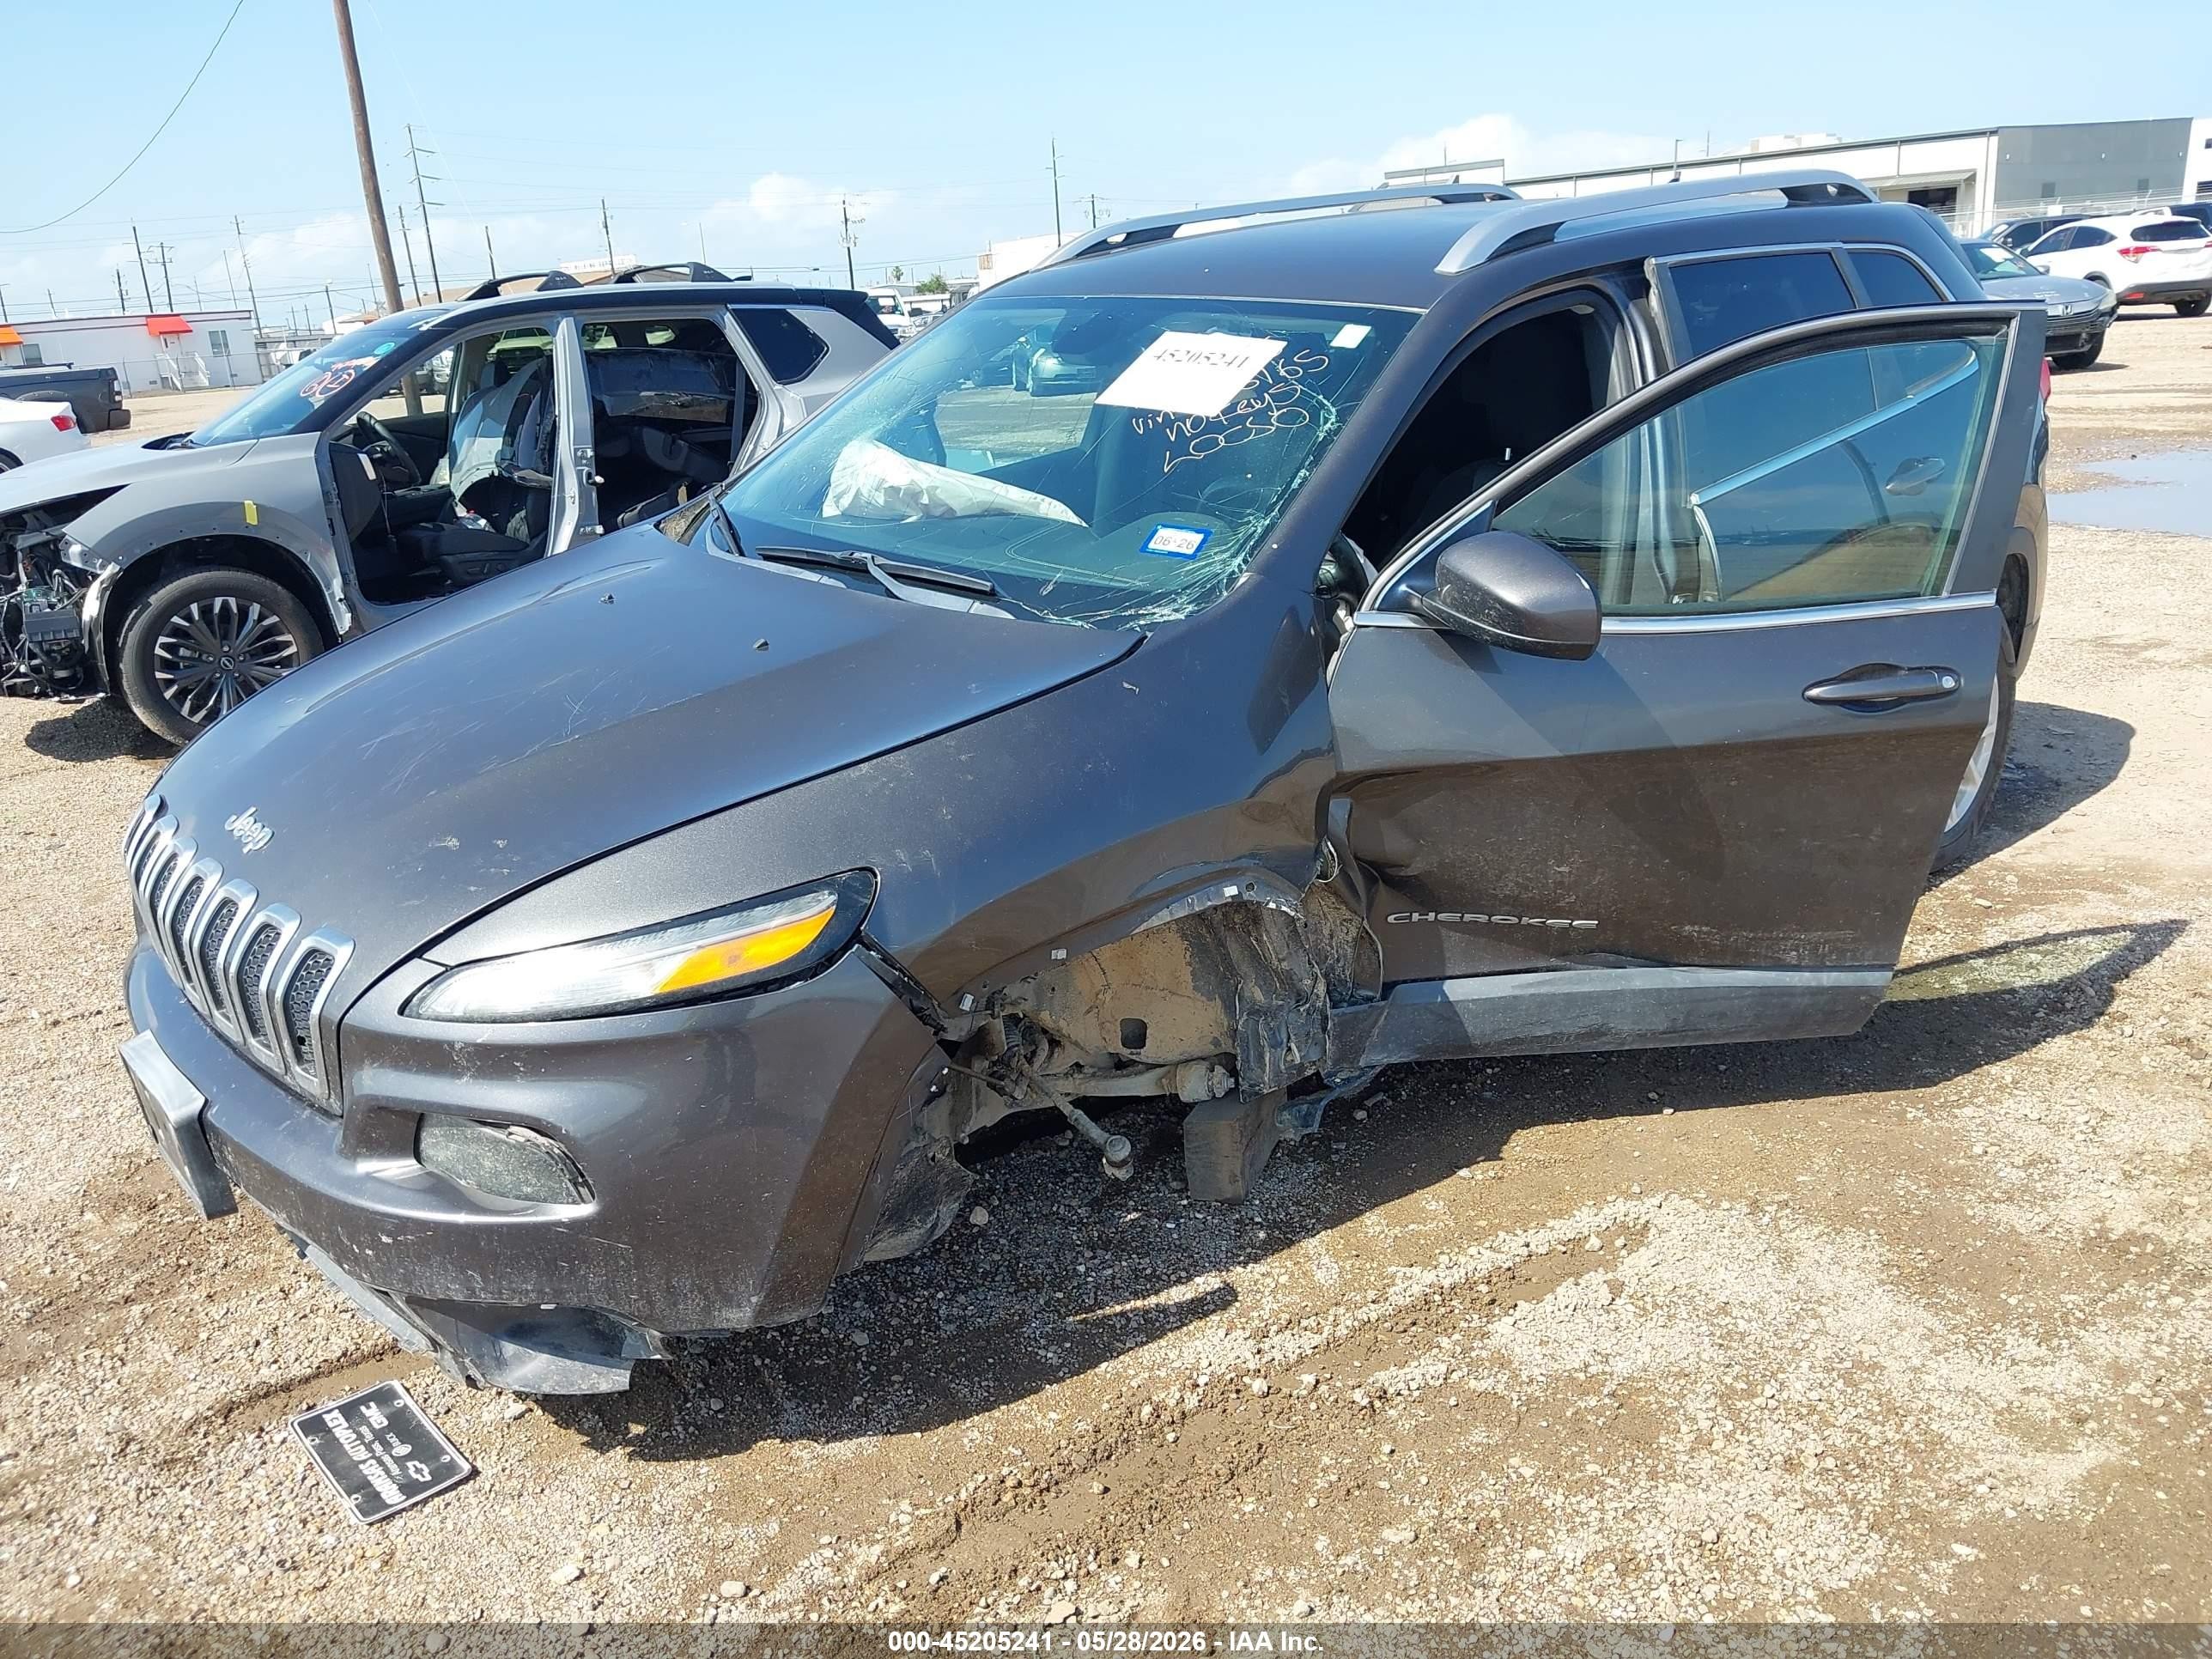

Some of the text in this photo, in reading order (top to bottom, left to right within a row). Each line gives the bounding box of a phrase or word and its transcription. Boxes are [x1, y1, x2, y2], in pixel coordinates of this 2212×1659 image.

[224, 806, 274, 854] Jeep
[1386, 911, 1600, 930] CHEROKEE
[360, 1401, 389, 1429] GMC
[322, 1408, 407, 1505] ARANSAS AUTOPLEX
